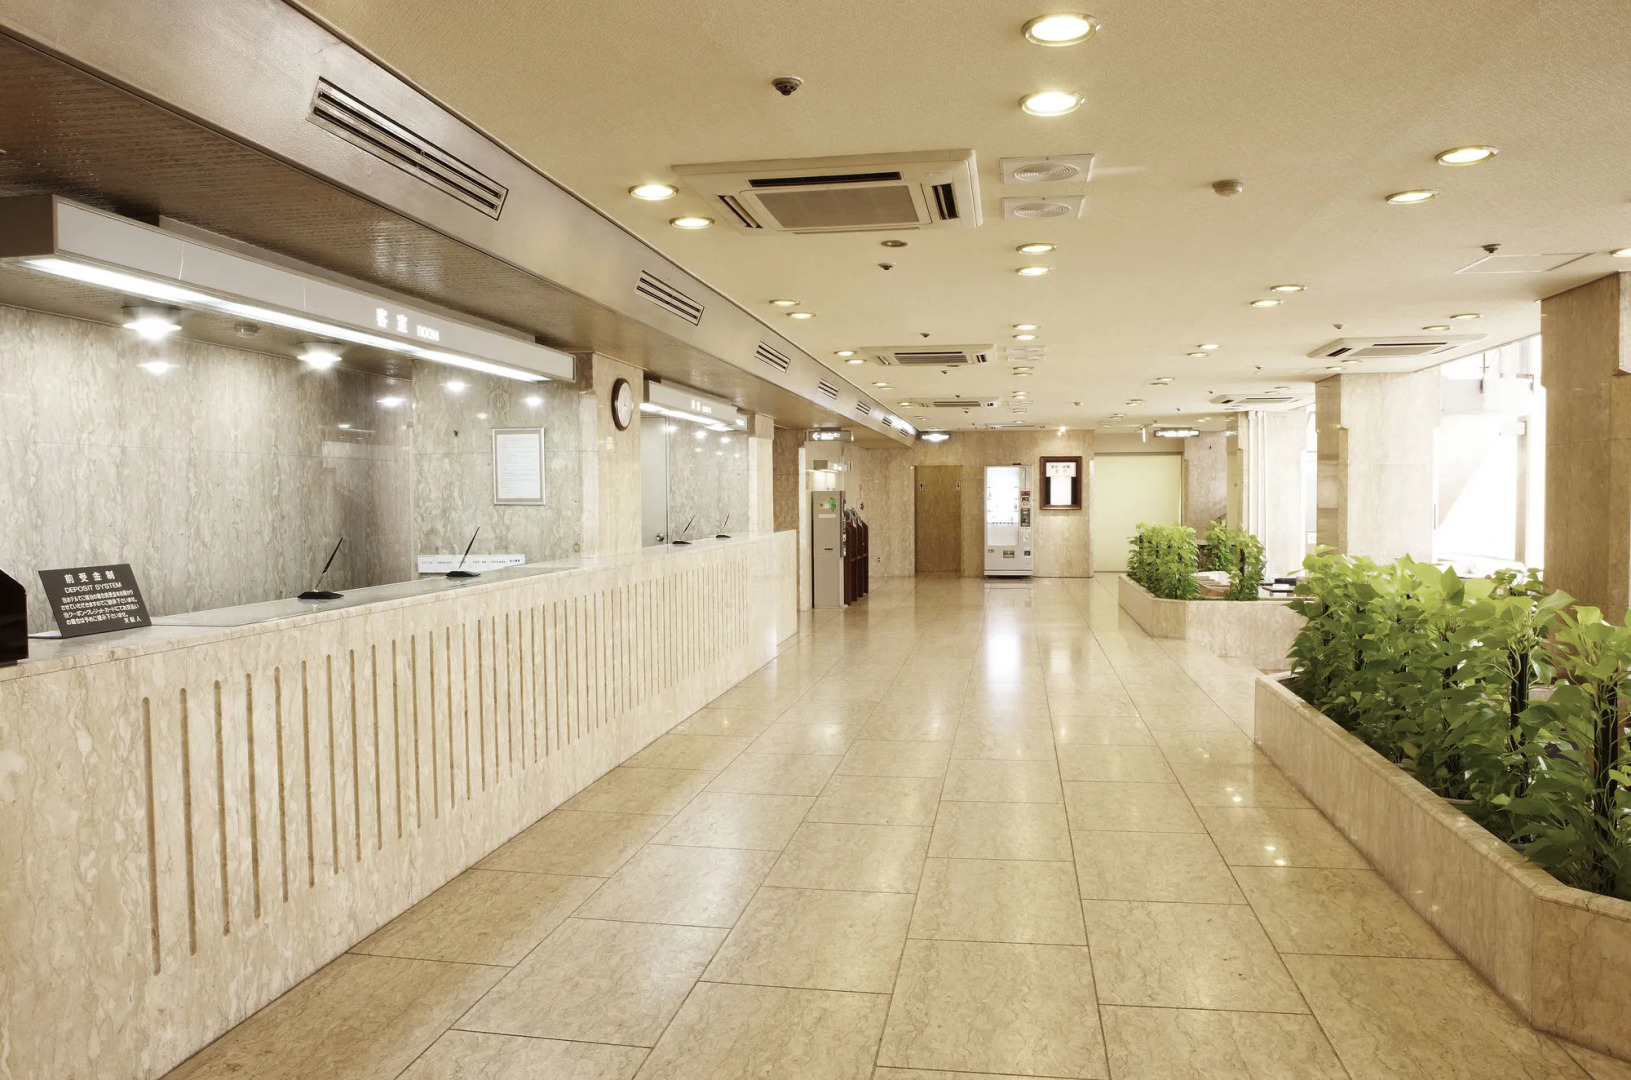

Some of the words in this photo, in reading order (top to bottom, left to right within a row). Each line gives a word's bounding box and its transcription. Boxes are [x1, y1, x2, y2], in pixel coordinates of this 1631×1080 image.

[417, 325, 440, 341] ROOM
[64, 585, 93, 593] DEPOSIT
[95, 582, 122, 591] SYSTEM
